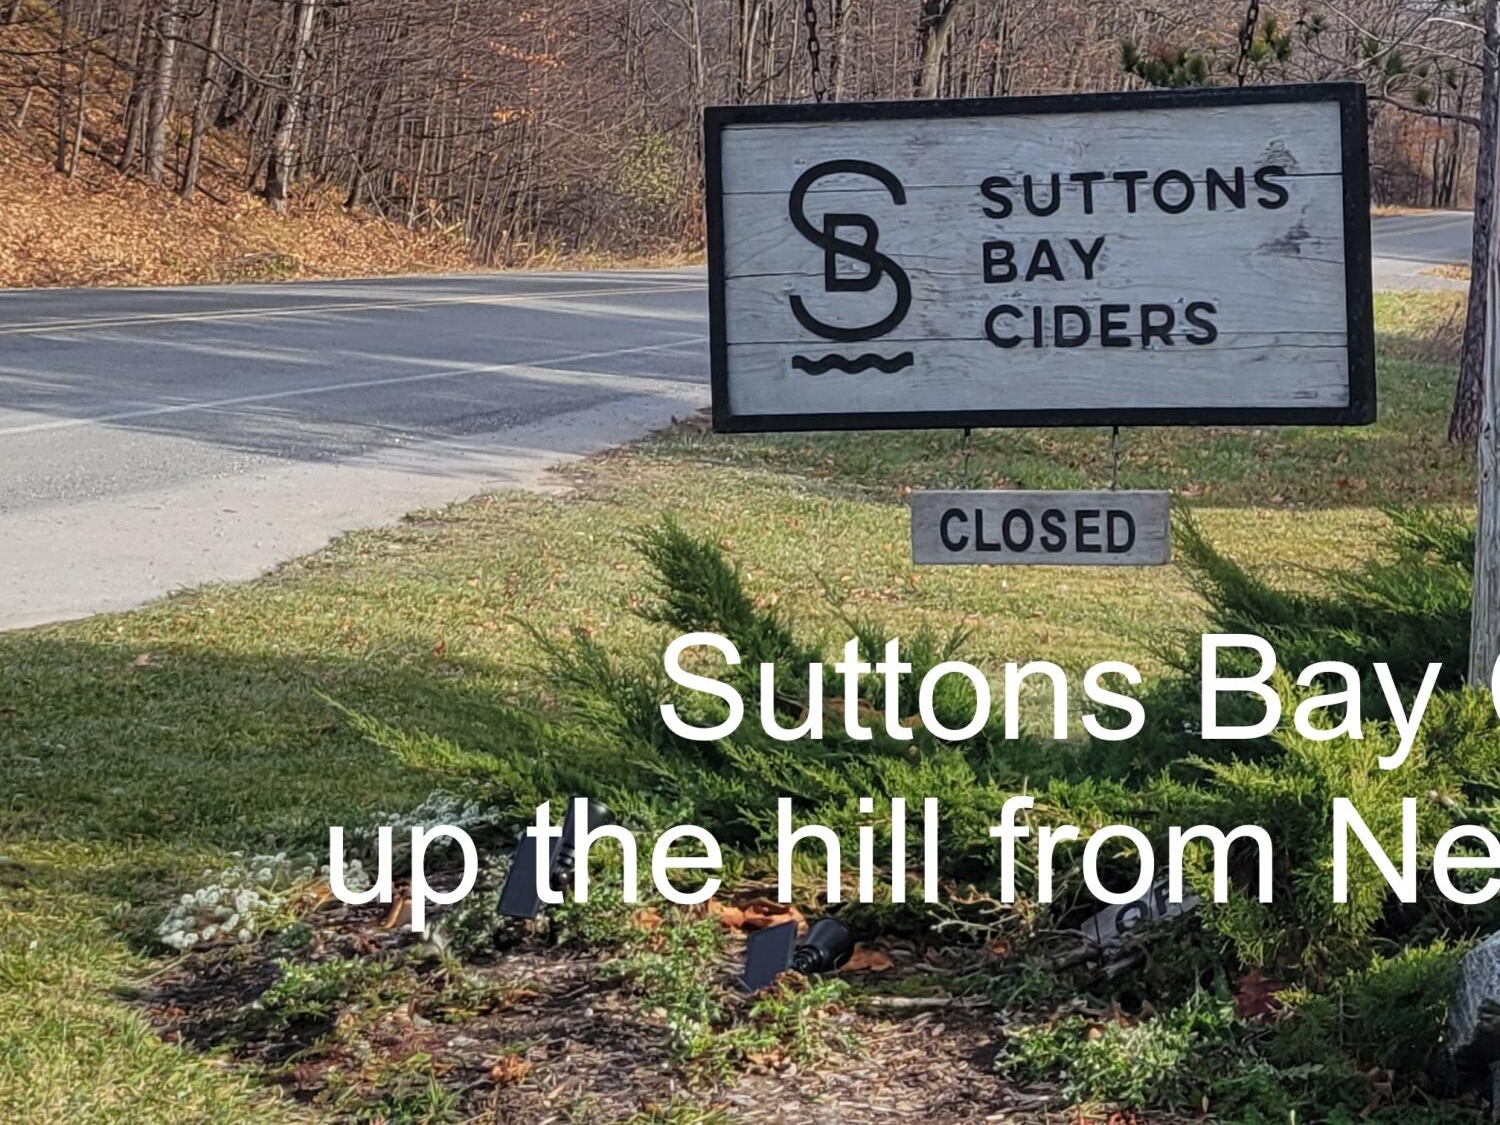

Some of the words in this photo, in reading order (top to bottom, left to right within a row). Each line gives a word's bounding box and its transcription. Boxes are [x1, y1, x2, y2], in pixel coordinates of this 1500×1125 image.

[977, 165, 1290, 219] SUTTONS
[983, 236, 1105, 284] BAY
[984, 301, 1218, 350] CIDERS
[939, 507, 1136, 553] CLOSED
